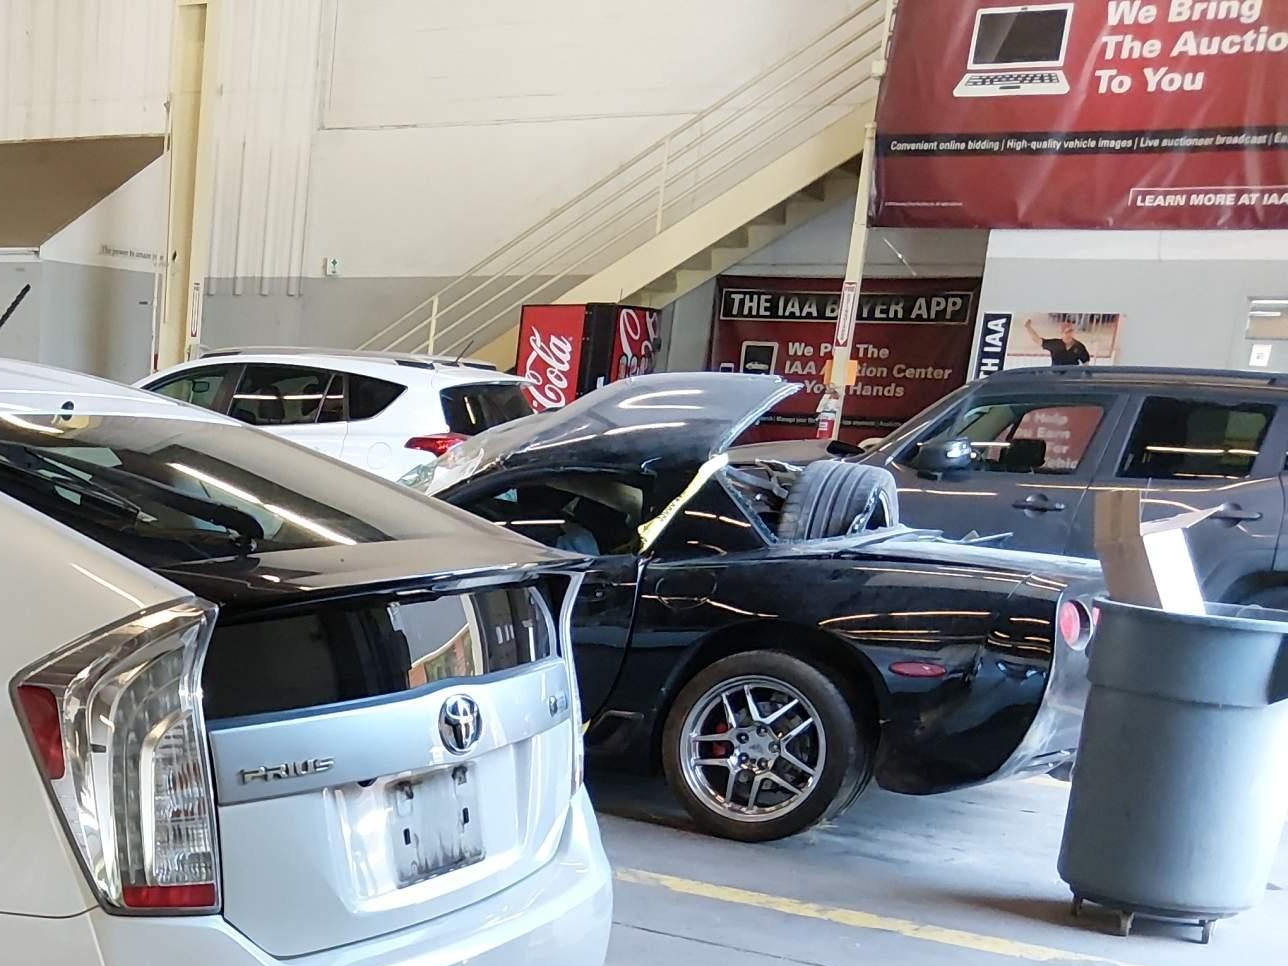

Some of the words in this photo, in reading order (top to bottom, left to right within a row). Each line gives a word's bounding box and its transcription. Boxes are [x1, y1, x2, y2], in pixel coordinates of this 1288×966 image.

[1107, 0, 1157, 26] We
[1167, 0, 1263, 24] Bring
[1101, 34, 1161, 60] The
[1170, 26, 1288, 57] Auctio
[1095, 69, 1132, 94] To
[1143, 66, 1205, 92] You
[890, 140, 937, 151] Convenient
[939, 139, 965, 150] online
[968, 139, 999, 152] bidding
[1007, 138, 1061, 151] High-quality
[1064, 137, 1096, 149] vehicle
[1098, 136, 1132, 150] images
[1140, 137, 1159, 147] Live
[1161, 135, 1214, 147] auctioneer
[1216, 134, 1267, 146] broadcast
[1136, 194, 1186, 207] LEARN
[1189, 193, 1236, 206] MORE
[1238, 193, 1261, 205] AT
[730, 293, 772, 316] THE
[778, 295, 817, 317] IAA
[825, 297, 906, 319] BYER
[911, 296, 963, 319] APP
[983, 317, 1007, 352] IAA
[788, 342, 814, 356] We
[856, 344, 889, 359] The
[784, 360, 816, 375] IAA
[893, 366, 952, 380] Center
[849, 384, 905, 398] Hands
[237, 757, 335, 784] PRIUS
